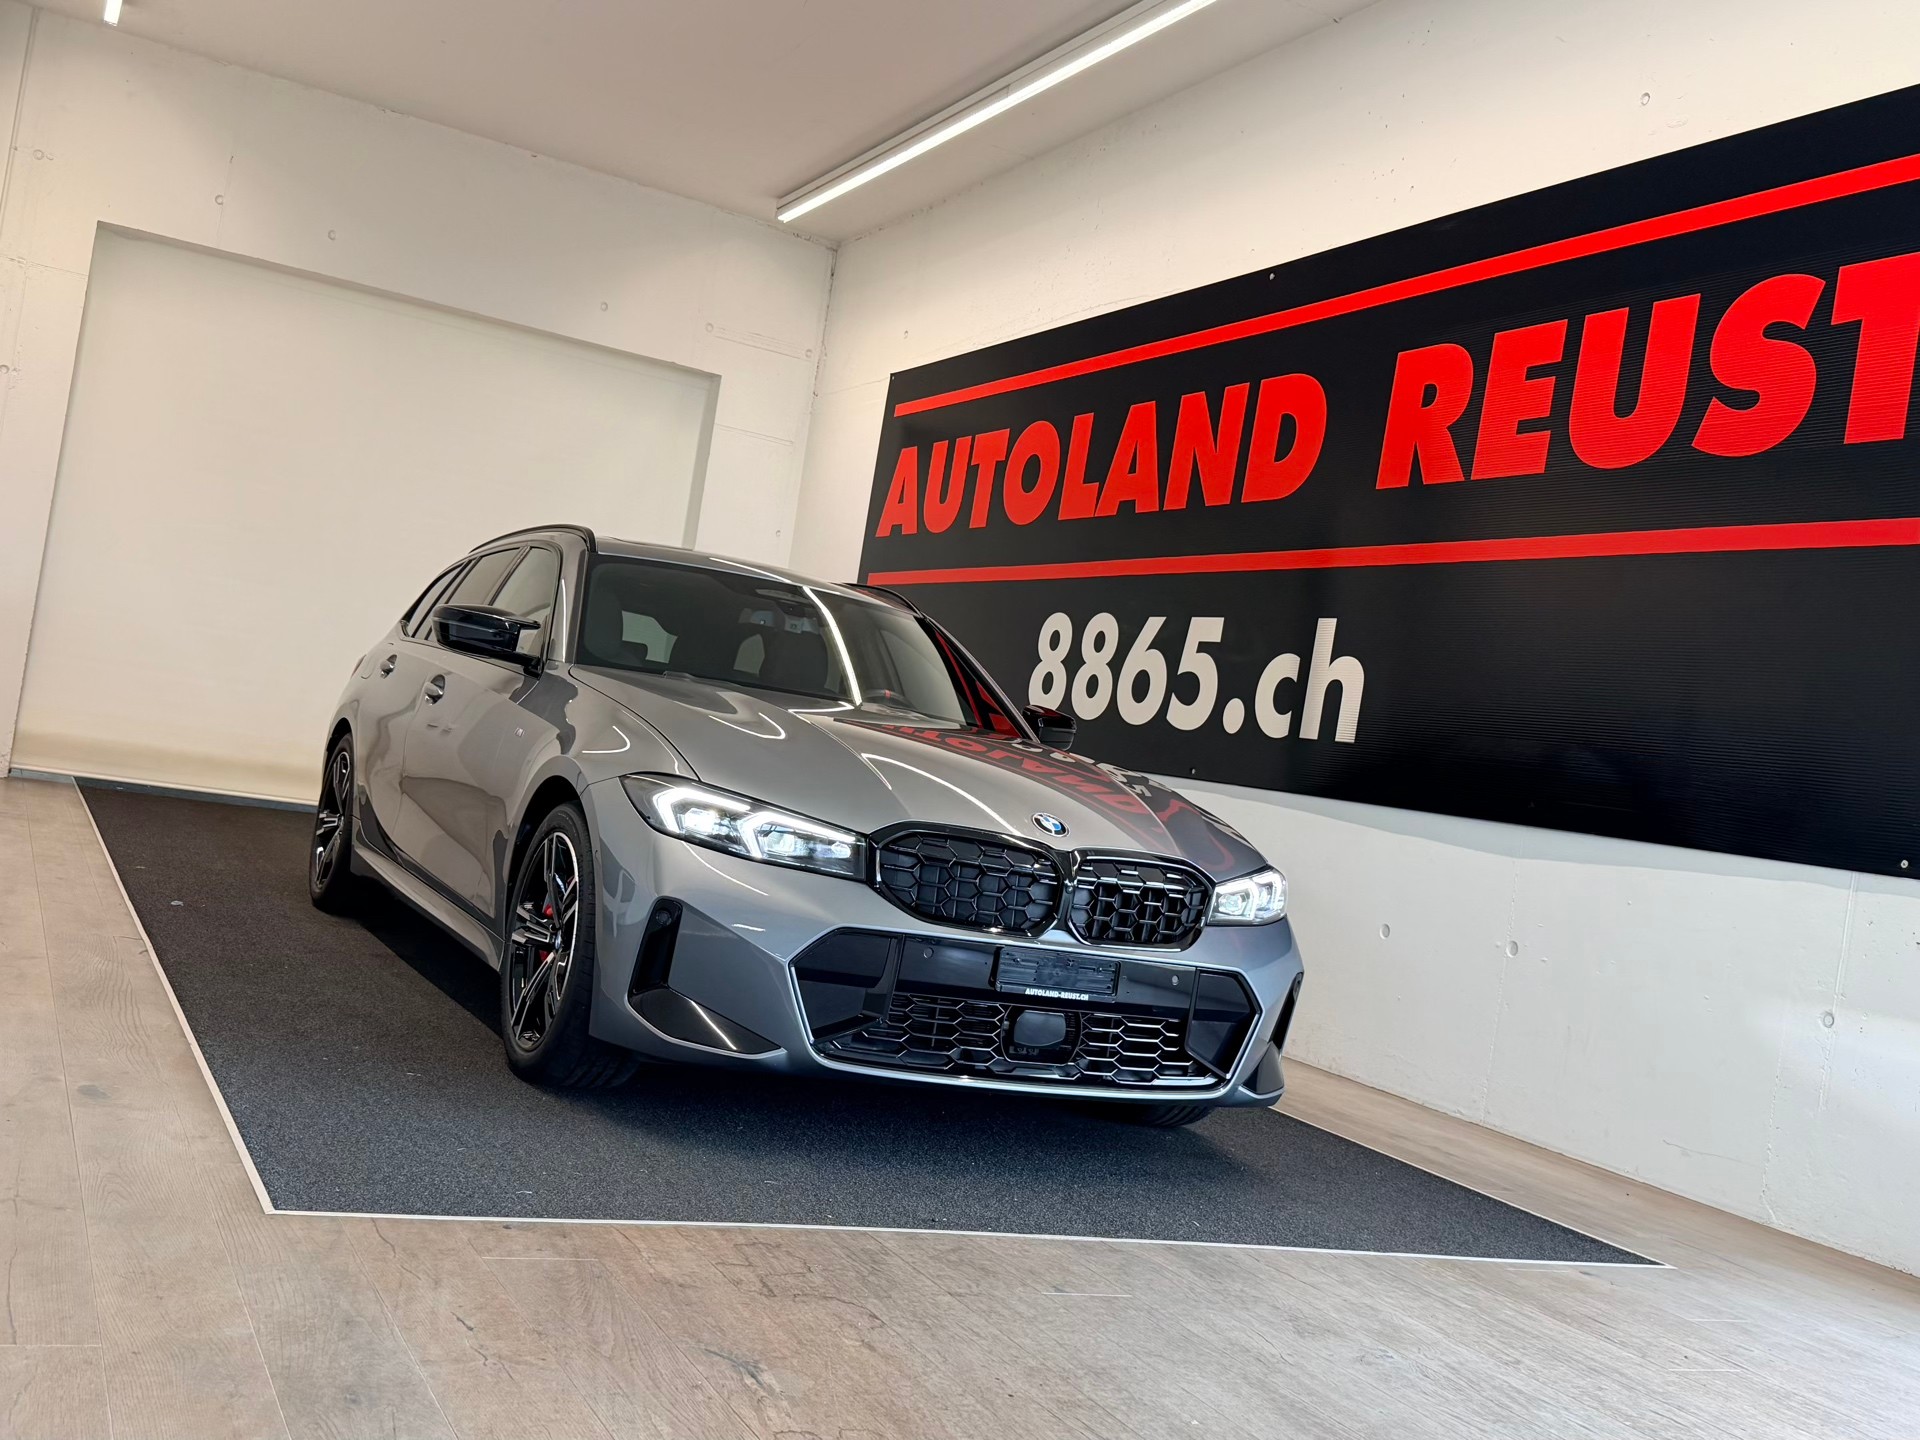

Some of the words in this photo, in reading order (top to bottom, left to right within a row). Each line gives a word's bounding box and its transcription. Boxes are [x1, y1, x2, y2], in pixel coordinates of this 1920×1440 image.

[875, 373, 1327, 538] AUTOLAND
[1376, 251, 1920, 489] REUST
[1028, 612, 1365, 743] 8865.ch
[1025, 988, 1089, 1001] AUTOLAND-REUST.CH
